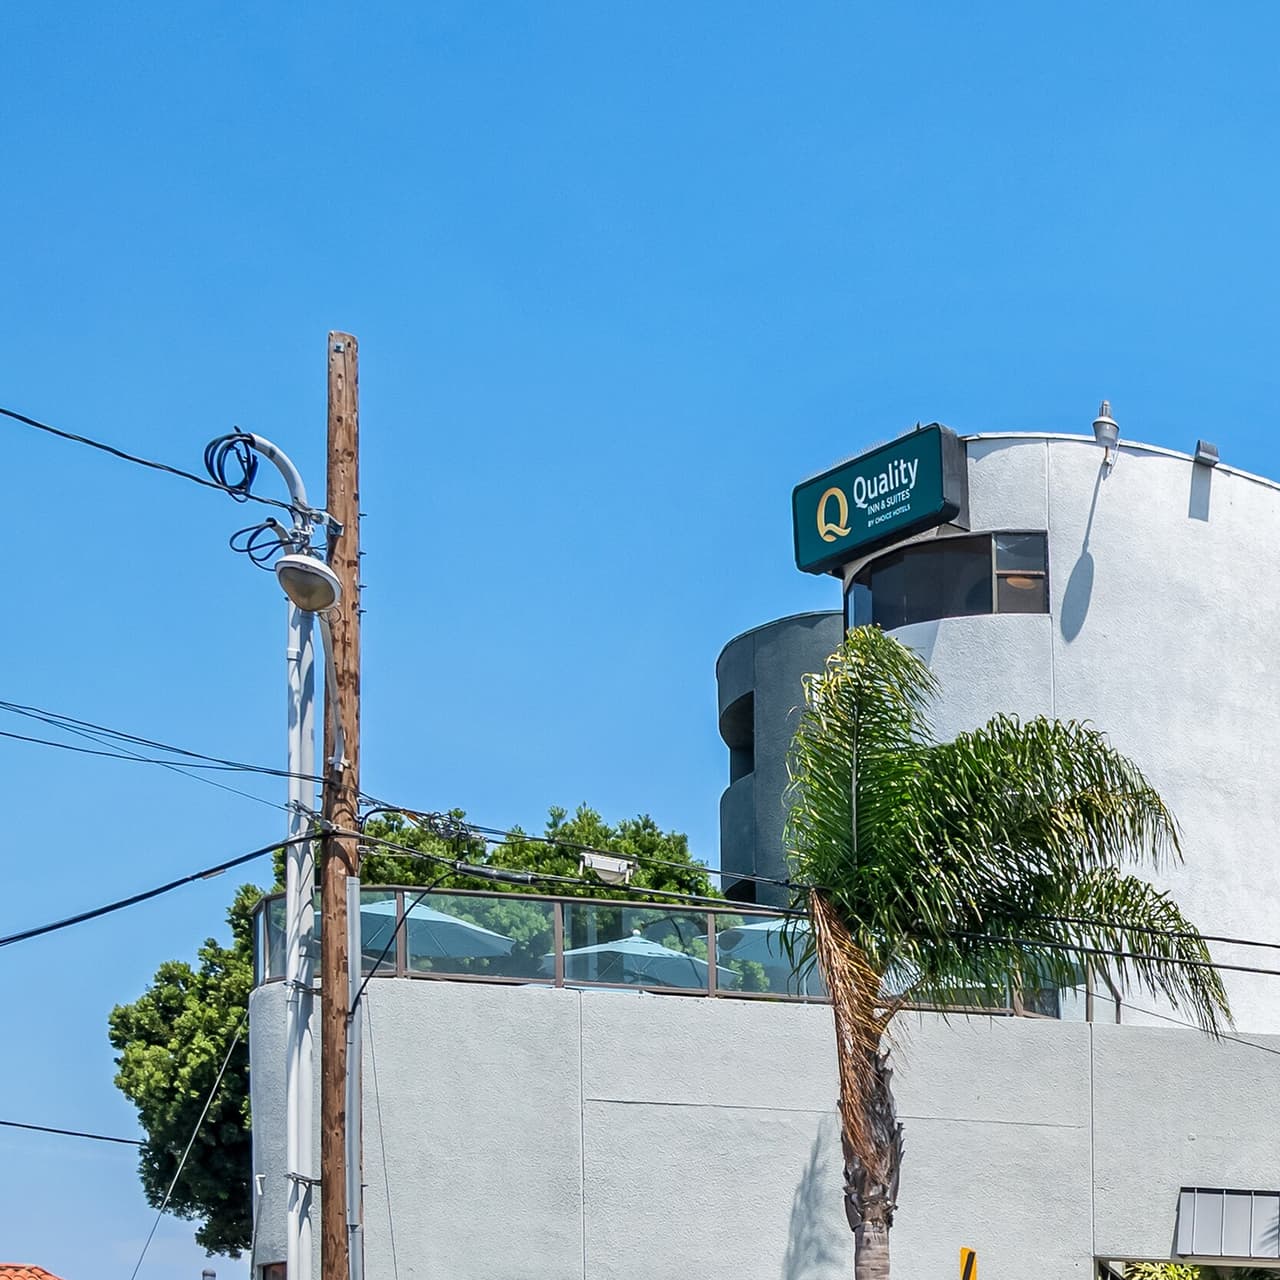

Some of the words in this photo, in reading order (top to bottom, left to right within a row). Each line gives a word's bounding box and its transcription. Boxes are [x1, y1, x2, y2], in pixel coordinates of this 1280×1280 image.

[853, 458, 919, 509] Quality
[867, 502, 880, 515] INN
[880, 500, 886, 510] &
[886, 489, 910, 508] SUITES
[817, 487, 851, 542] Q
